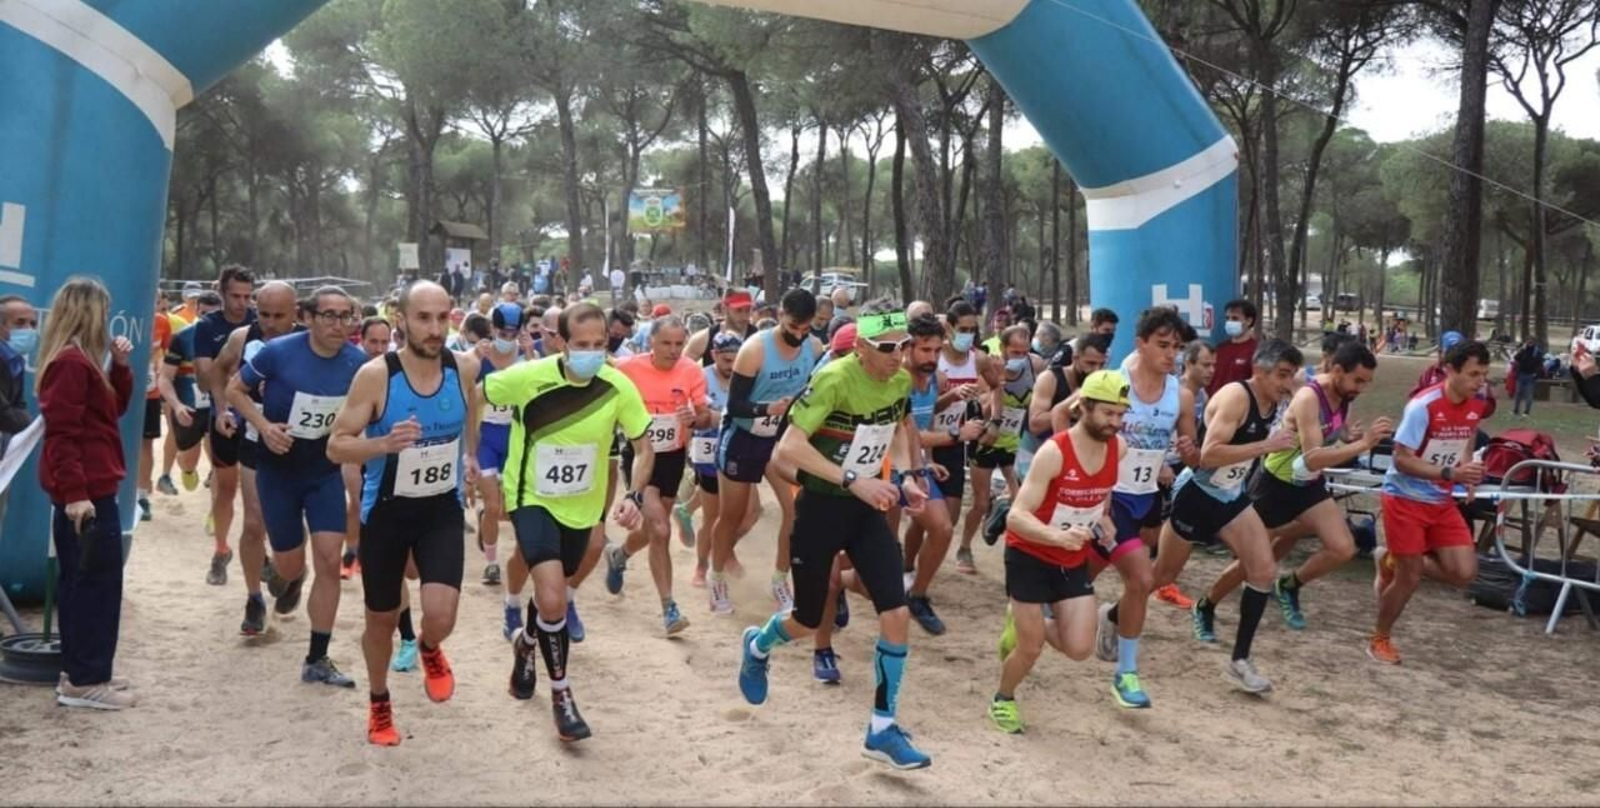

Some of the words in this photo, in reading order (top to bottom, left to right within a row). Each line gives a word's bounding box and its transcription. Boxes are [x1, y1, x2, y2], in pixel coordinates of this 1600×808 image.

[769, 366, 800, 380] nerja
[300, 411, 336, 429] 230
[647, 428, 676, 444] 298
[1430, 452, 1457, 467] 516
[409, 462, 452, 486] 188
[546, 464, 587, 484] 487
[1133, 466, 1153, 483] 13
